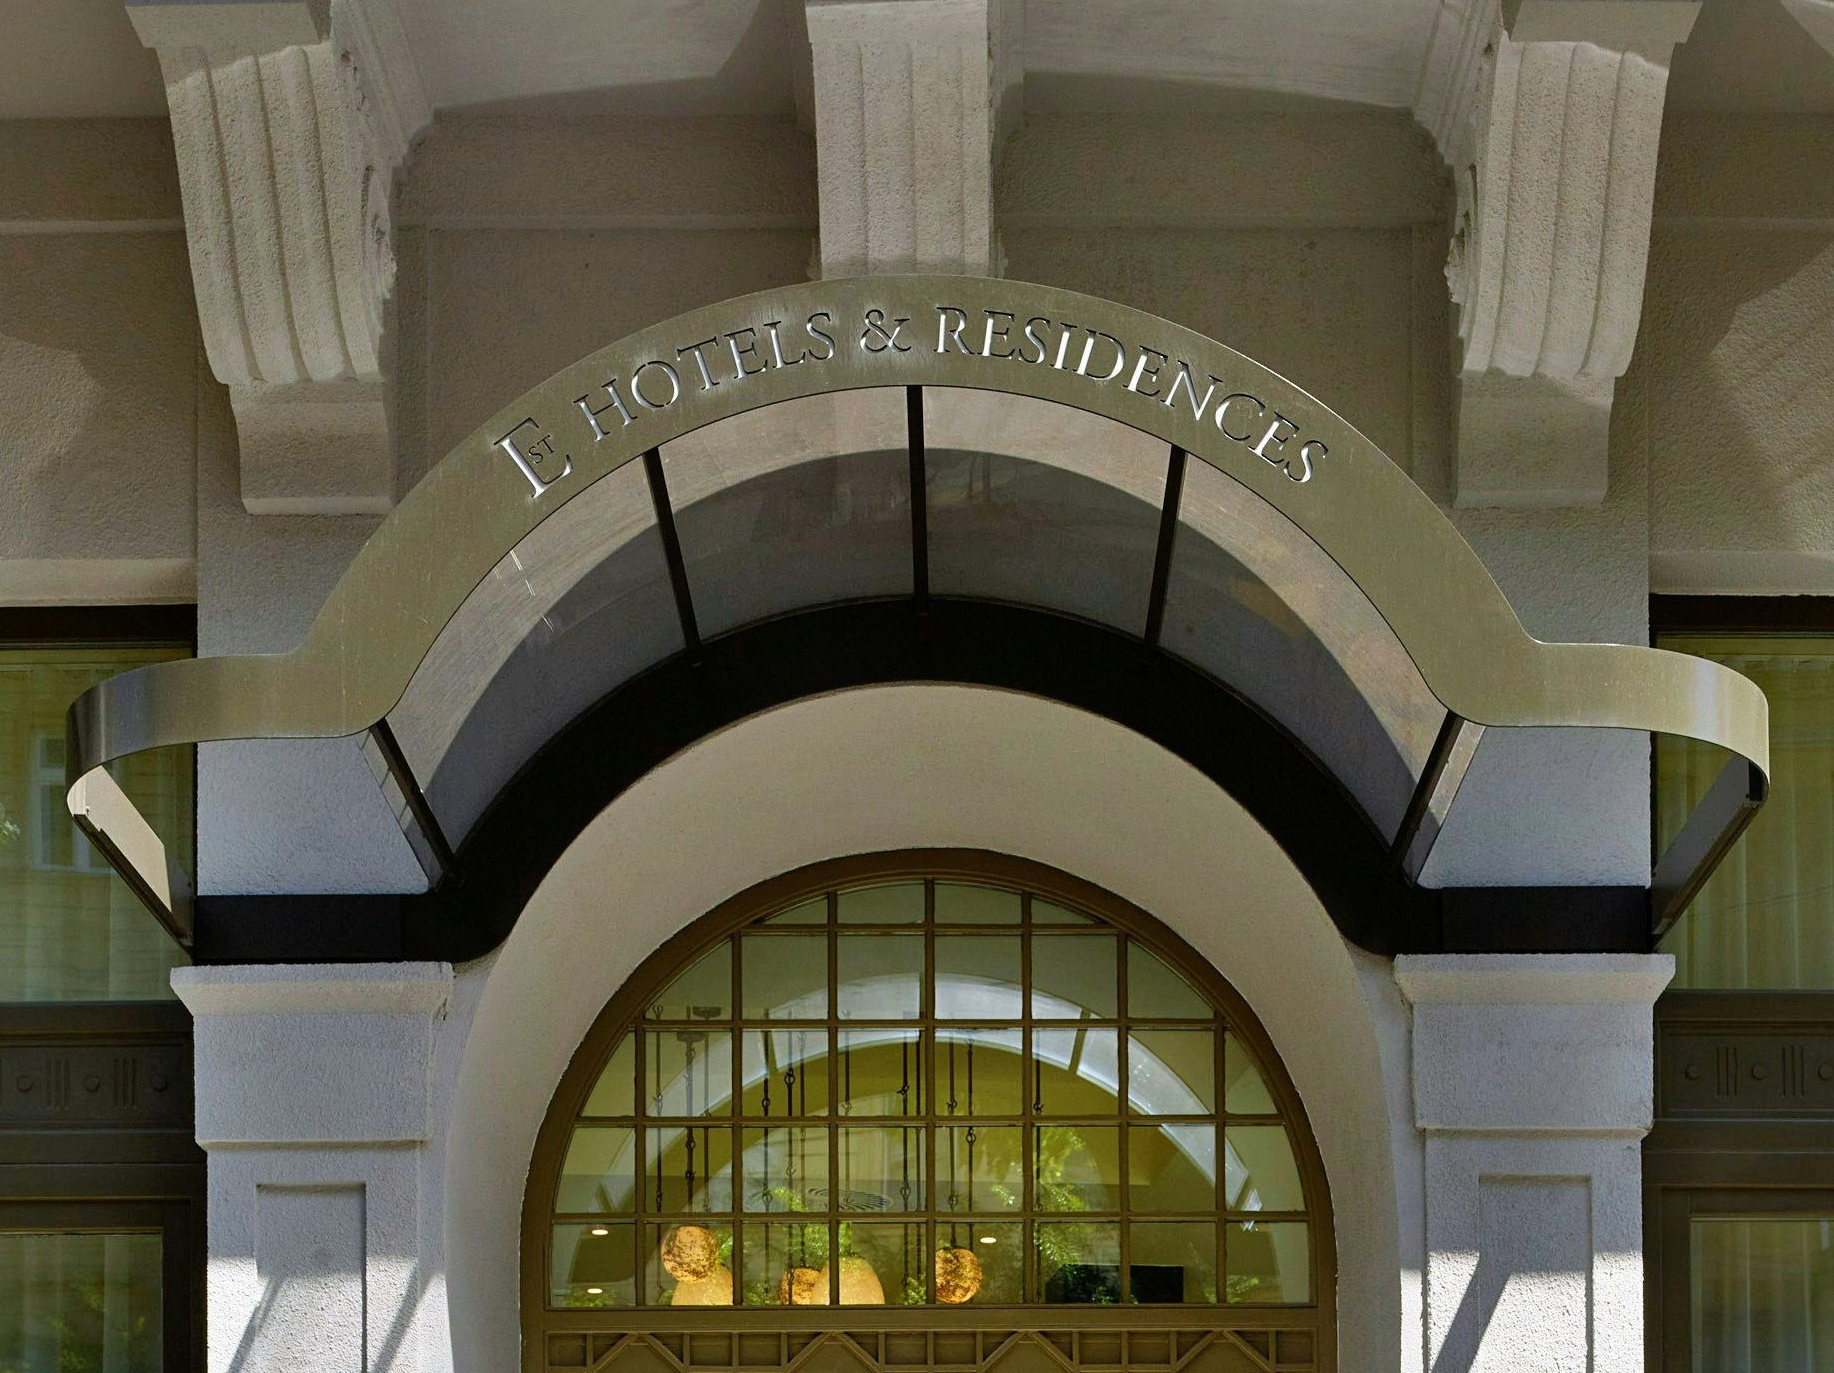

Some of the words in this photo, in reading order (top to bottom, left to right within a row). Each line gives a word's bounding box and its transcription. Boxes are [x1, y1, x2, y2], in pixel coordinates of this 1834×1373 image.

[573, 311, 836, 442] HOTELS
[860, 309, 912, 353] &
[933, 306, 1329, 483] RESIDENCES
